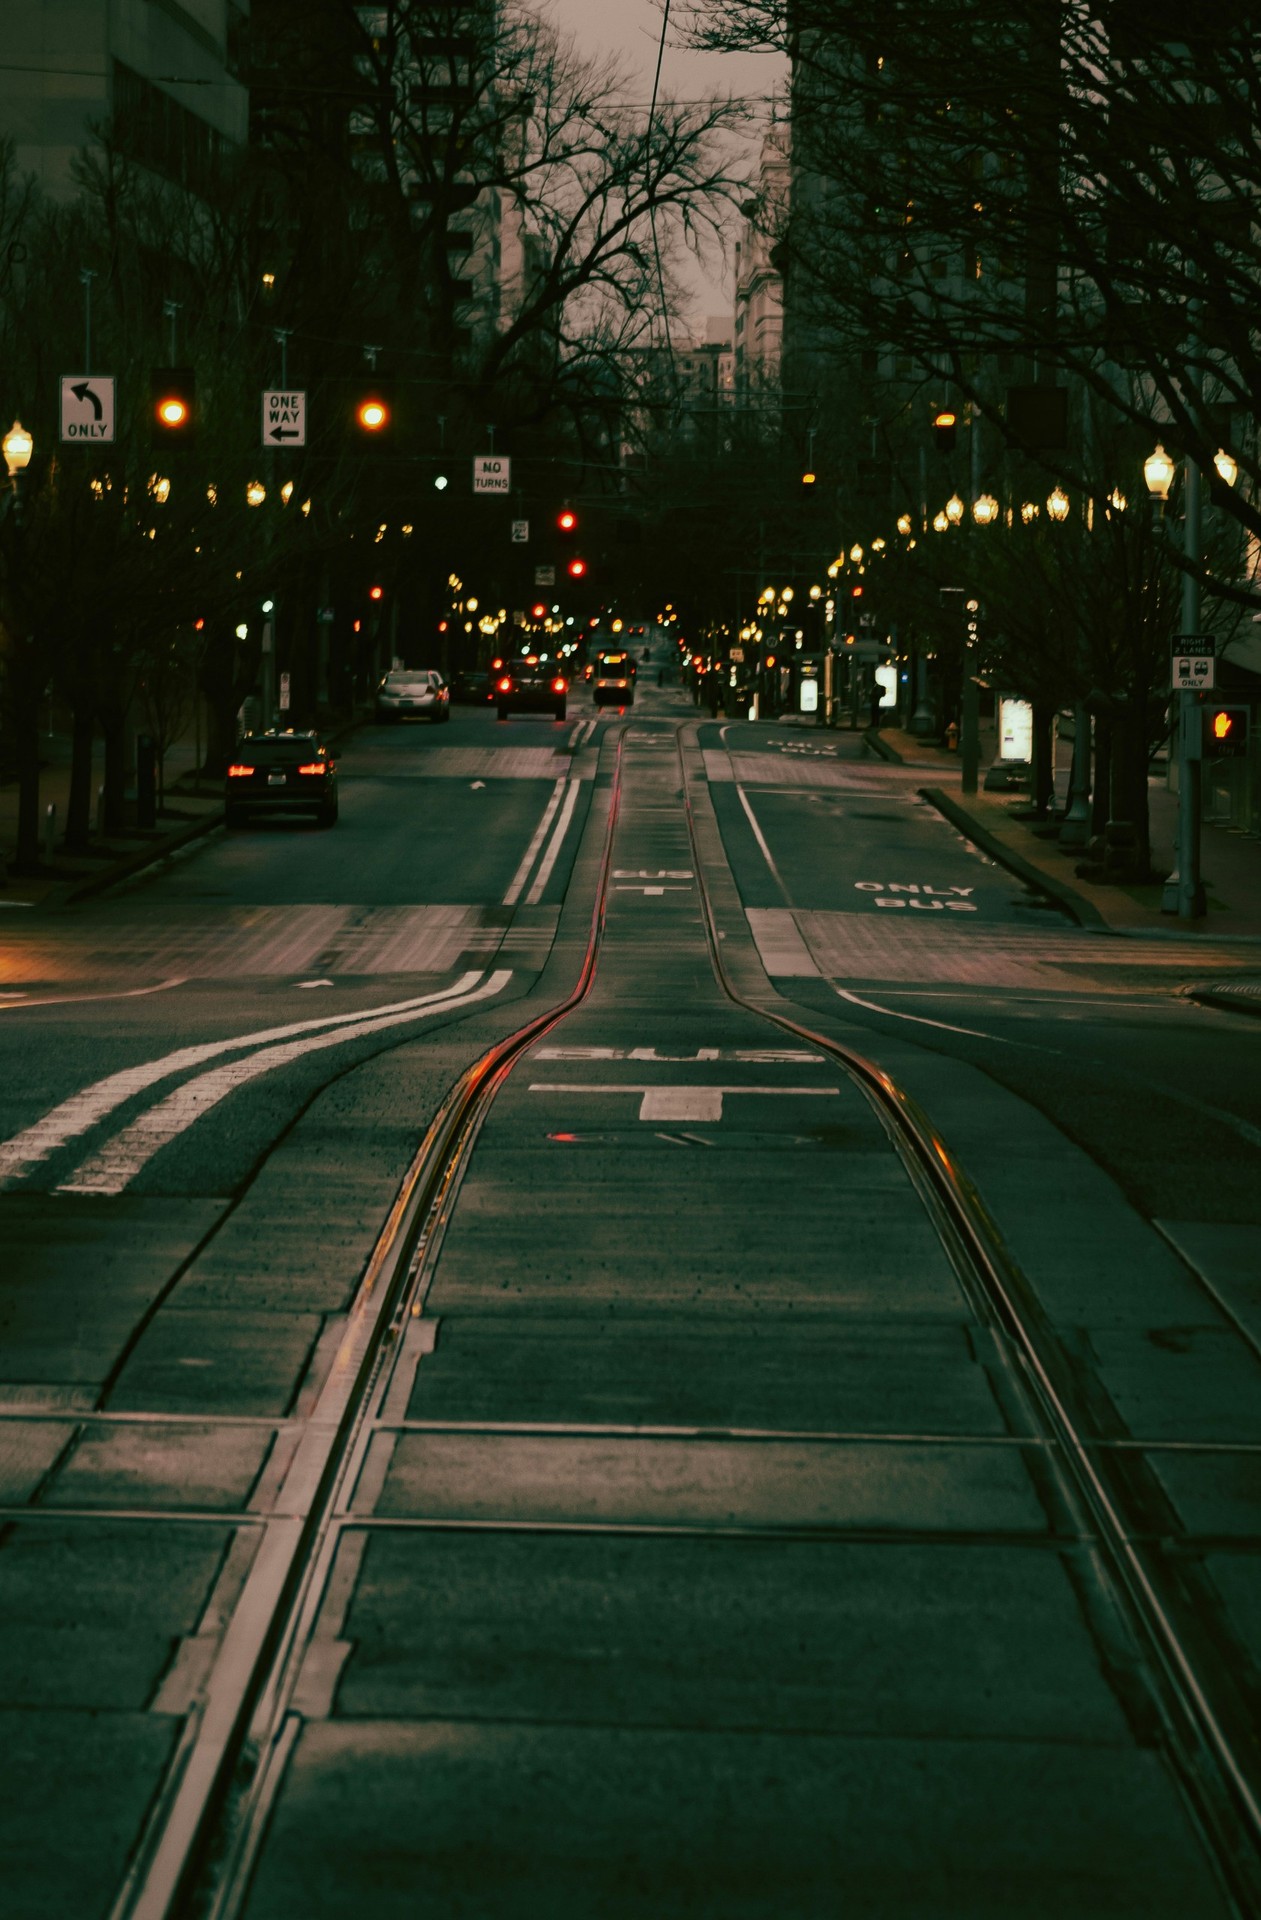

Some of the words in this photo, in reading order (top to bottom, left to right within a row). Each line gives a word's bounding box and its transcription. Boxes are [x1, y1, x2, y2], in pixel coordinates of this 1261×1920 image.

[270, 395, 299, 409] ONE
[269, 410, 300, 424] WAY
[68, 424, 108, 437] ONLY
[483, 461, 502, 474] NO
[475, 478, 508, 489] TURNS
[1180, 638, 1206, 646] RIGHT
[1175, 646, 1181, 654] 2
[1183, 646, 1213, 654] LANES
[1182, 679, 1204, 687] ONLY
[613, 870, 694, 879] BUS
[854, 881, 975, 897] ONLY
[873, 897, 978, 912] BUS
[533, 1047, 827, 1063] BUS
